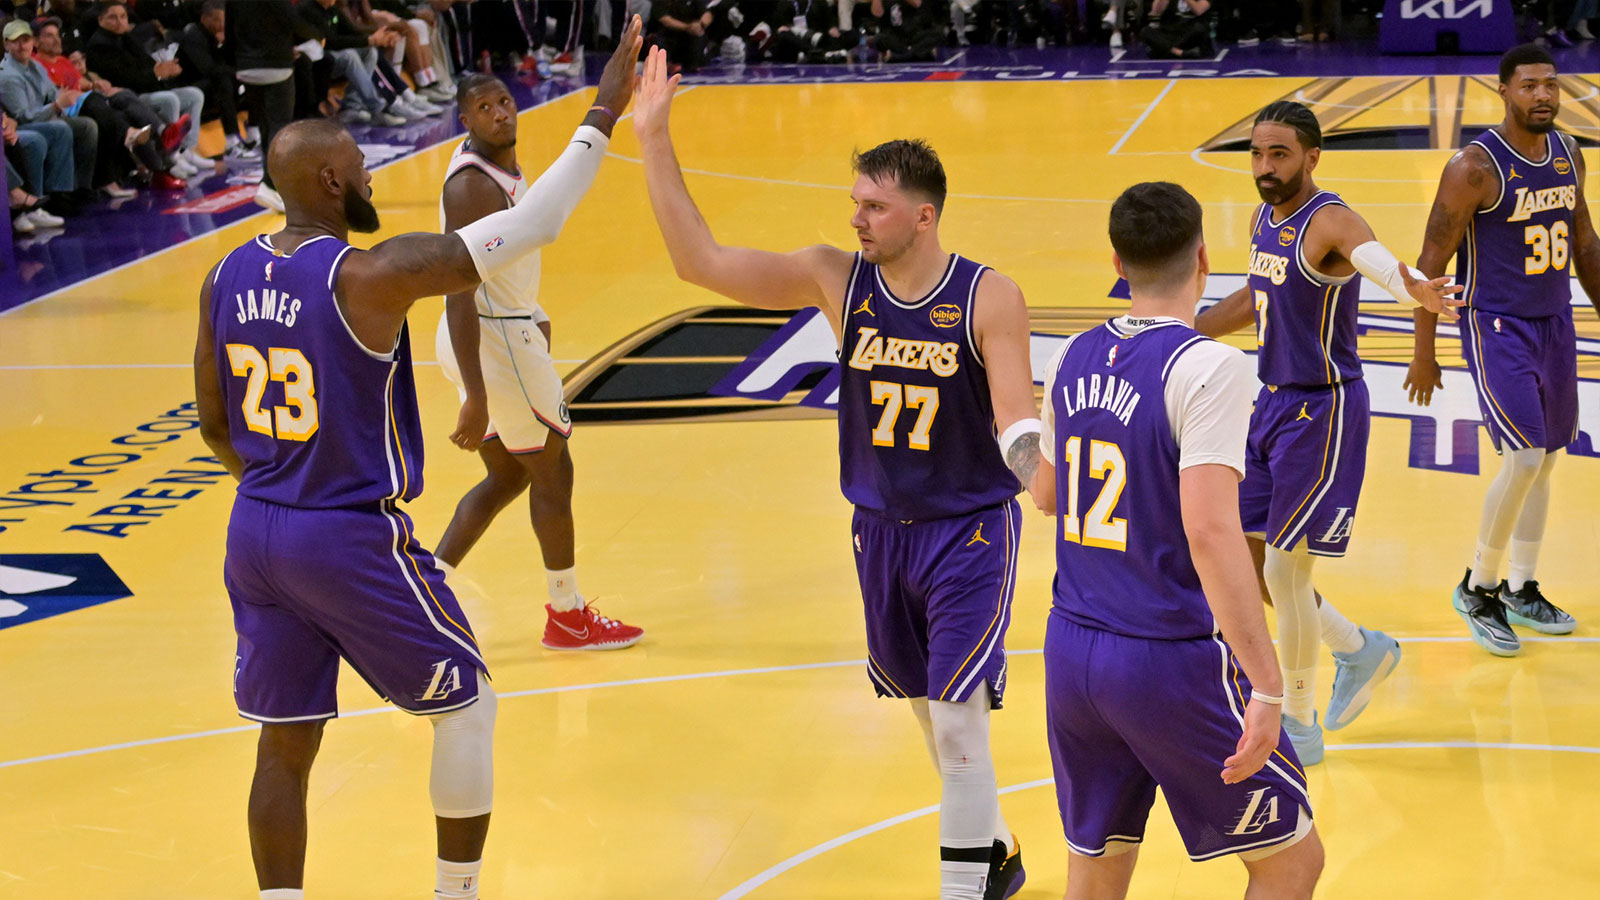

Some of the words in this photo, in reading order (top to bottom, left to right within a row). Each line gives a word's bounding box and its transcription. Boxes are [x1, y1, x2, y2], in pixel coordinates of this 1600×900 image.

[1401, 0, 1492, 18] KIA
[995, 69, 1279, 78] ULTRA
[1506, 184, 1576, 222] LAKERS
[1524, 220, 1569, 276] 36
[236, 288, 302, 328] JAMES
[933, 310, 960, 321] bibigo
[1254, 289, 1269, 347] 7
[848, 326, 960, 378] LAKERS
[225, 343, 319, 442] 23
[870, 380, 940, 451] 77
[1063, 373, 1141, 427] LARAVIA
[1064, 435, 1128, 552] 12
[415, 658, 463, 702] LA
[1225, 786, 1281, 835] LA
